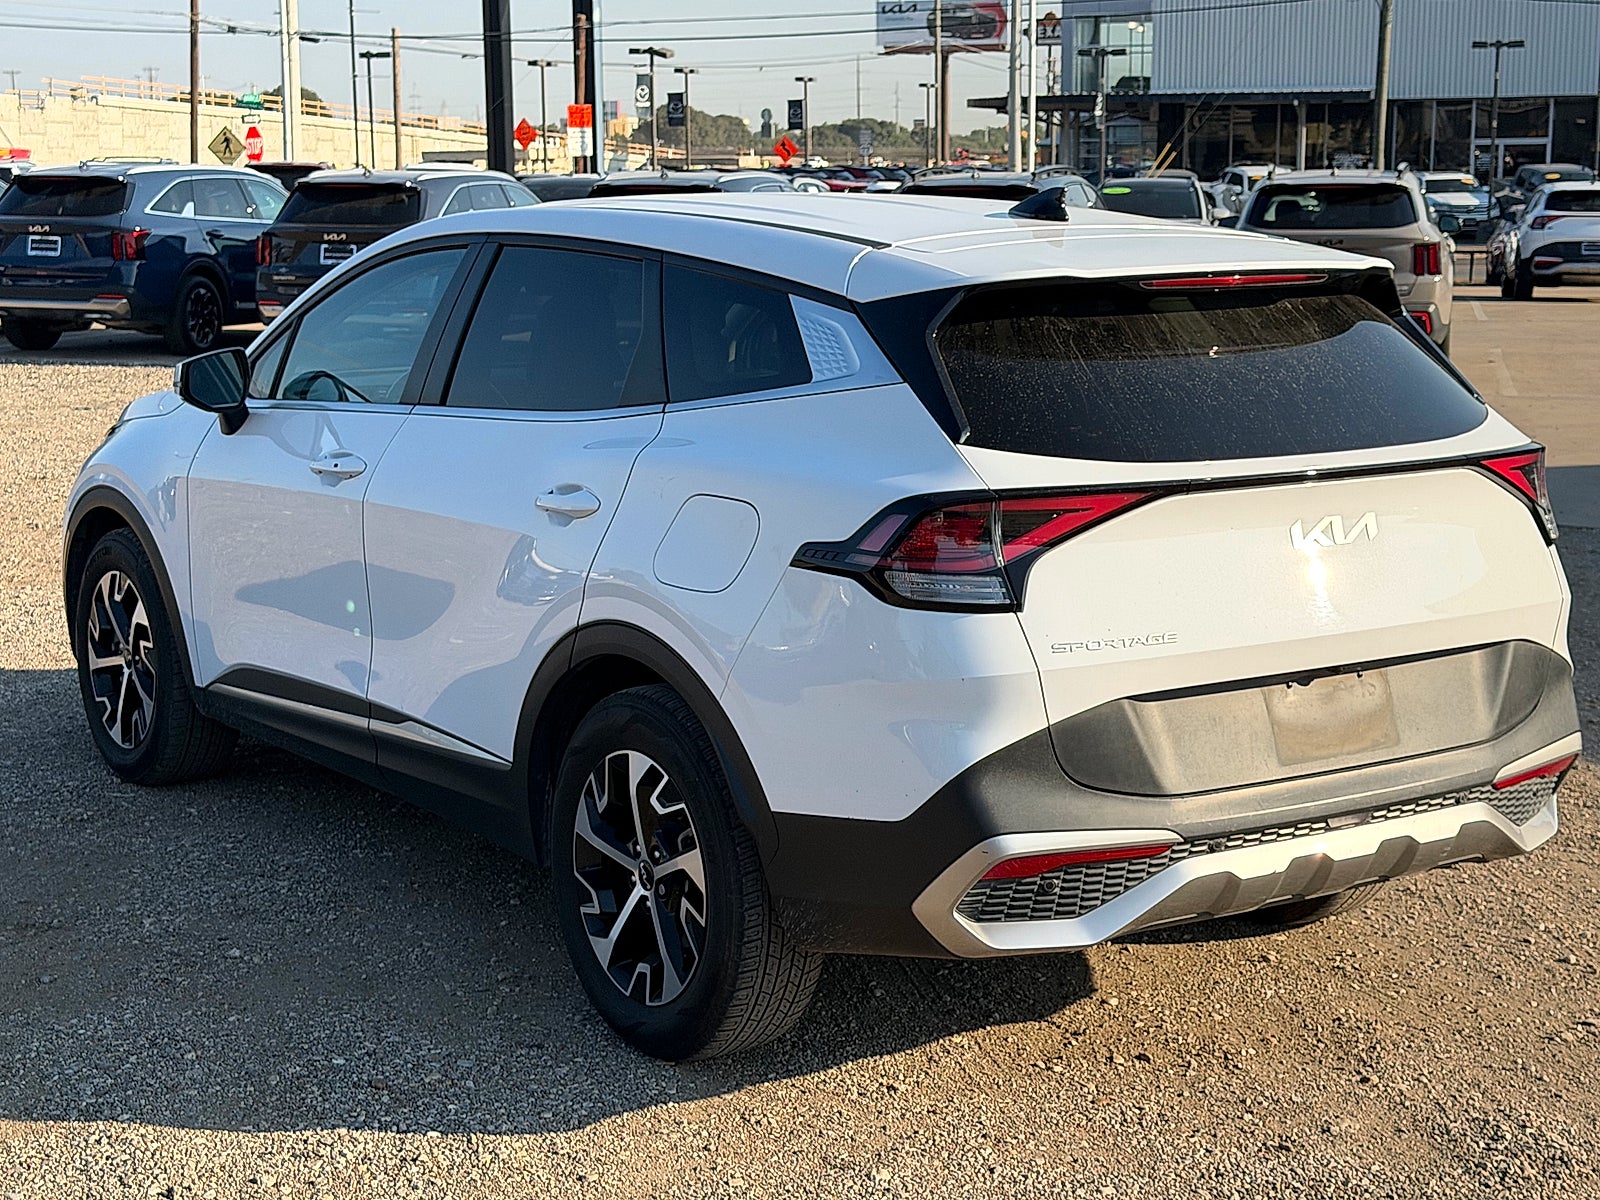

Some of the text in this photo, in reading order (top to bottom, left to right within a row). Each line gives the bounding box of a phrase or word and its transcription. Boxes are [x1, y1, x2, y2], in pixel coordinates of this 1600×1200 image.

[1037, 26, 1062, 38] EXA
[247, 139, 262, 155] STOP
[323, 233, 347, 241] KIA
[1290, 511, 1379, 549] KIA
[1051, 631, 1177, 653] SPORTAGE
